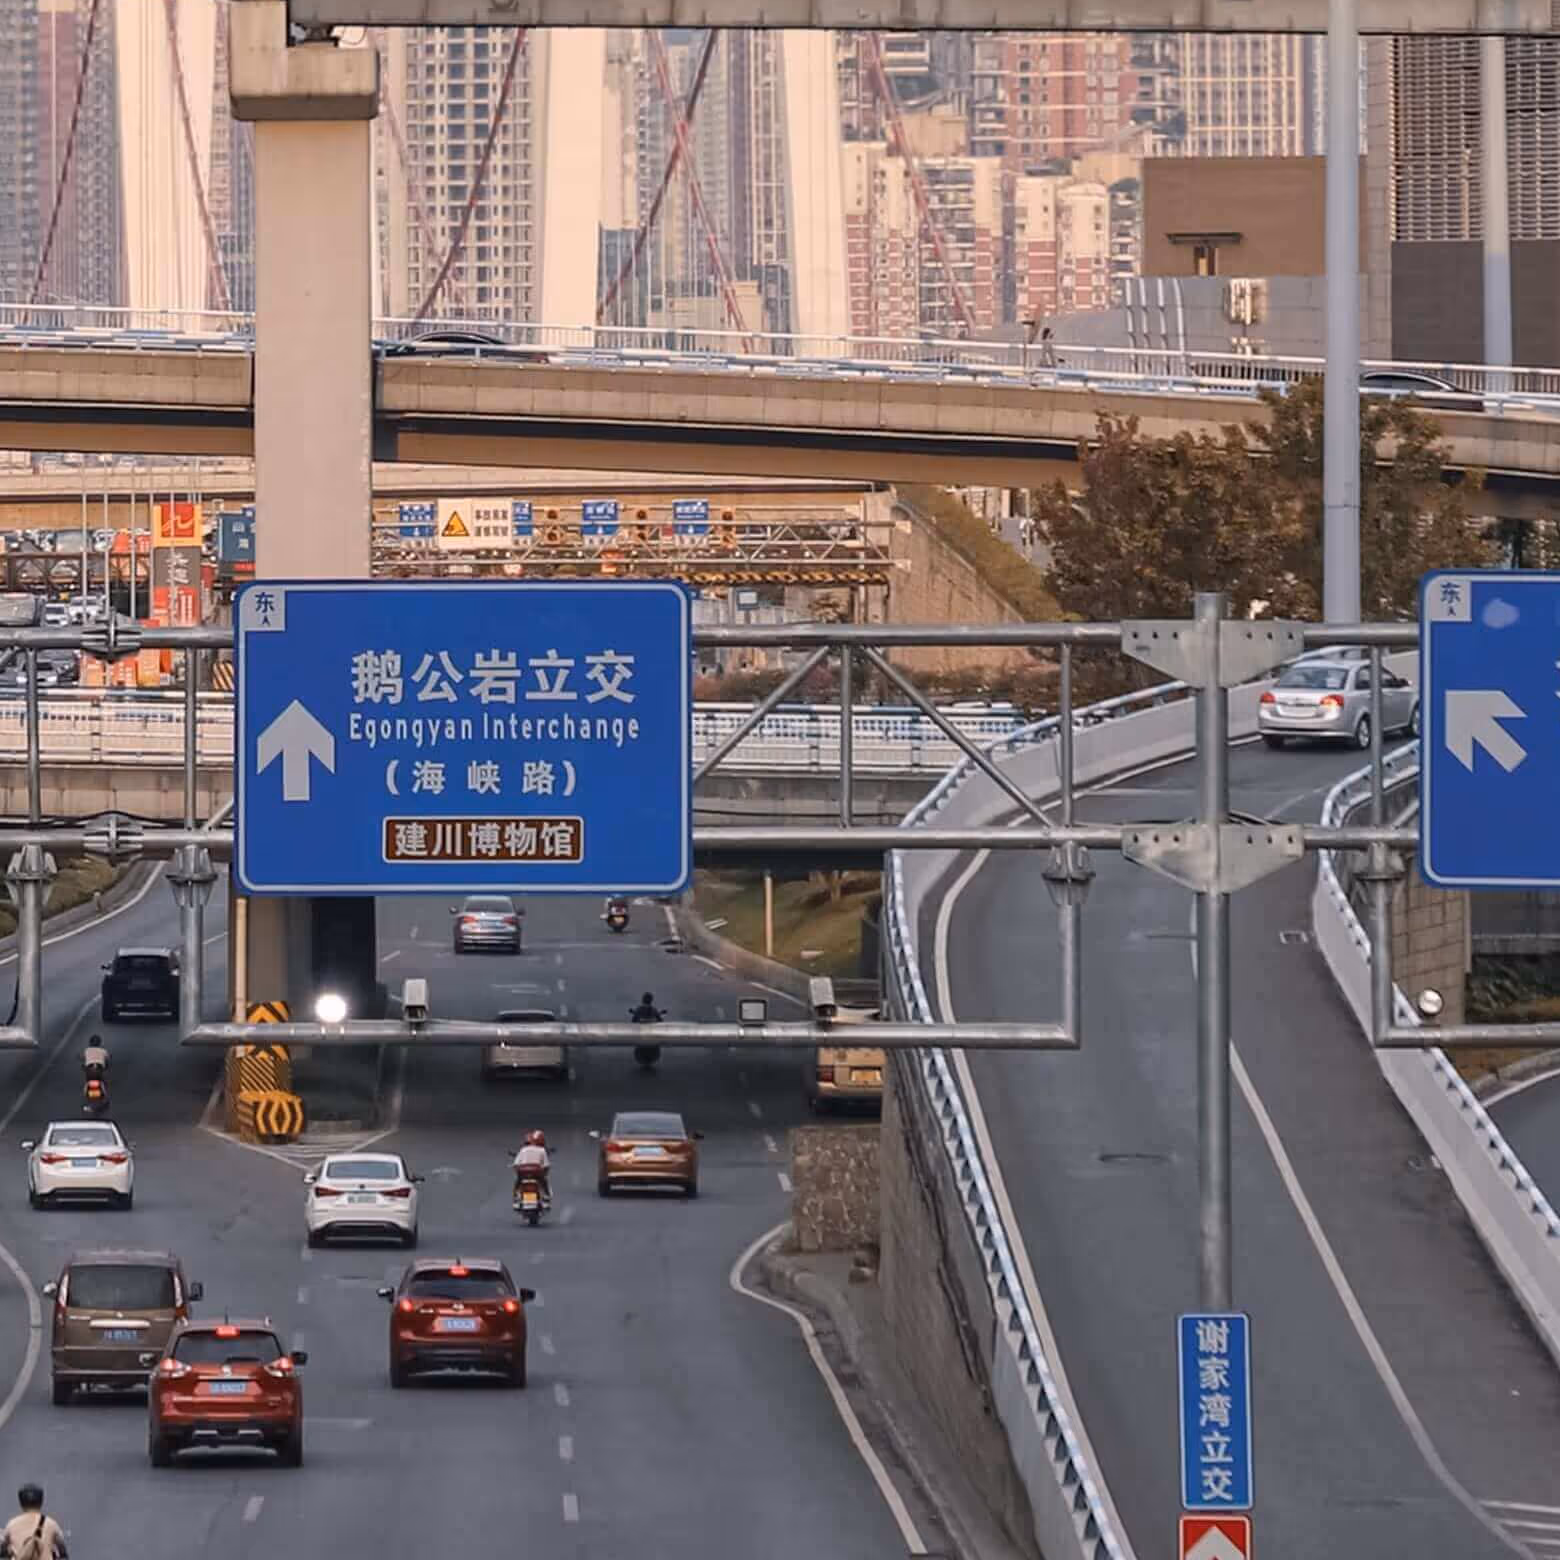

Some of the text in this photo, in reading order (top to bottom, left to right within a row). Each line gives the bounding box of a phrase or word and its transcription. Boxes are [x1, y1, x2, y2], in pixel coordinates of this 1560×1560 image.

[254, 591, 275, 614] 东
[1440, 582, 1461, 604] 东
[350, 648, 637, 705] 鹅公岩立交
[349, 712, 641, 750] Egongyan Interchange
[394, 822, 576, 858] 建川博物馆
[1195, 1319, 1234, 1502] 谢家湾立交
